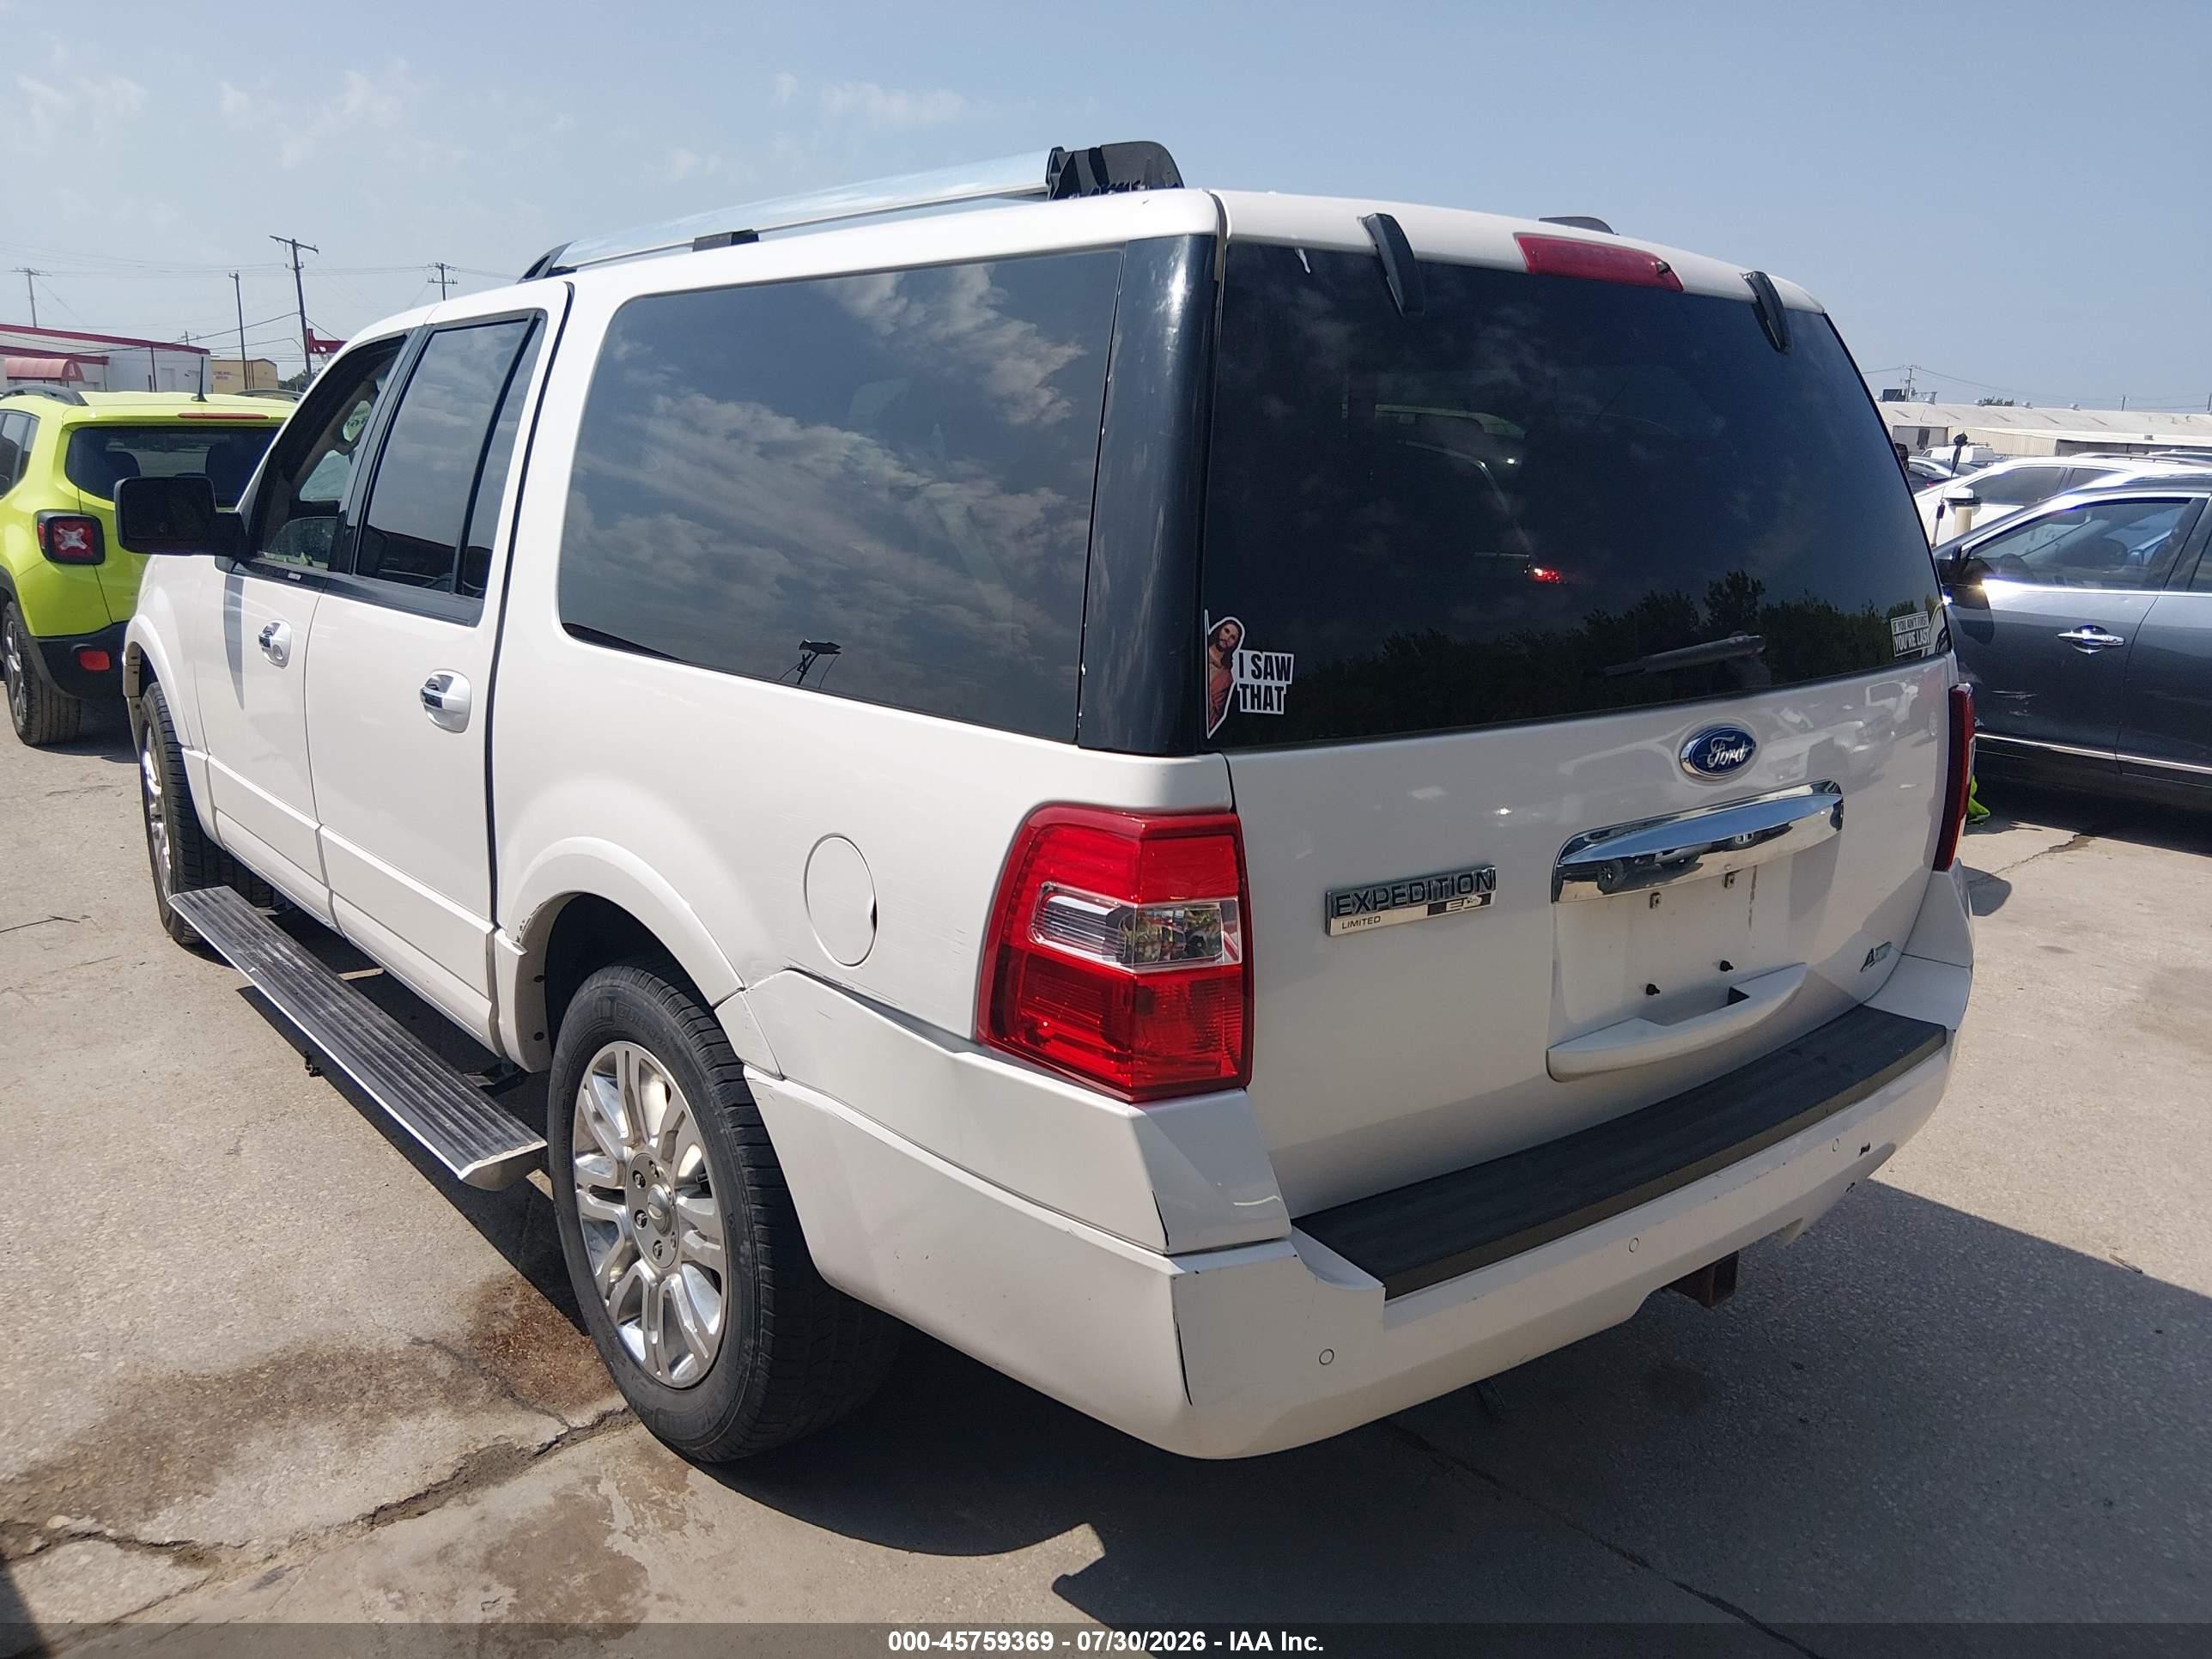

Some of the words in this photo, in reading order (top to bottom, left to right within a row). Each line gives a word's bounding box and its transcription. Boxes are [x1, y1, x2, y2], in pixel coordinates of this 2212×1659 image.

[1894, 632, 1917, 652] YOU'RE
[1917, 629, 1930, 645] LAST
[1239, 652, 1244, 678] I
[1250, 653, 1291, 682] SAW
[1239, 684, 1285, 712] THAT
[1706, 736, 1753, 769] Ford
[1335, 868, 1497, 916] EXPEDITION
[1341, 915, 1382, 930] LIMITED
